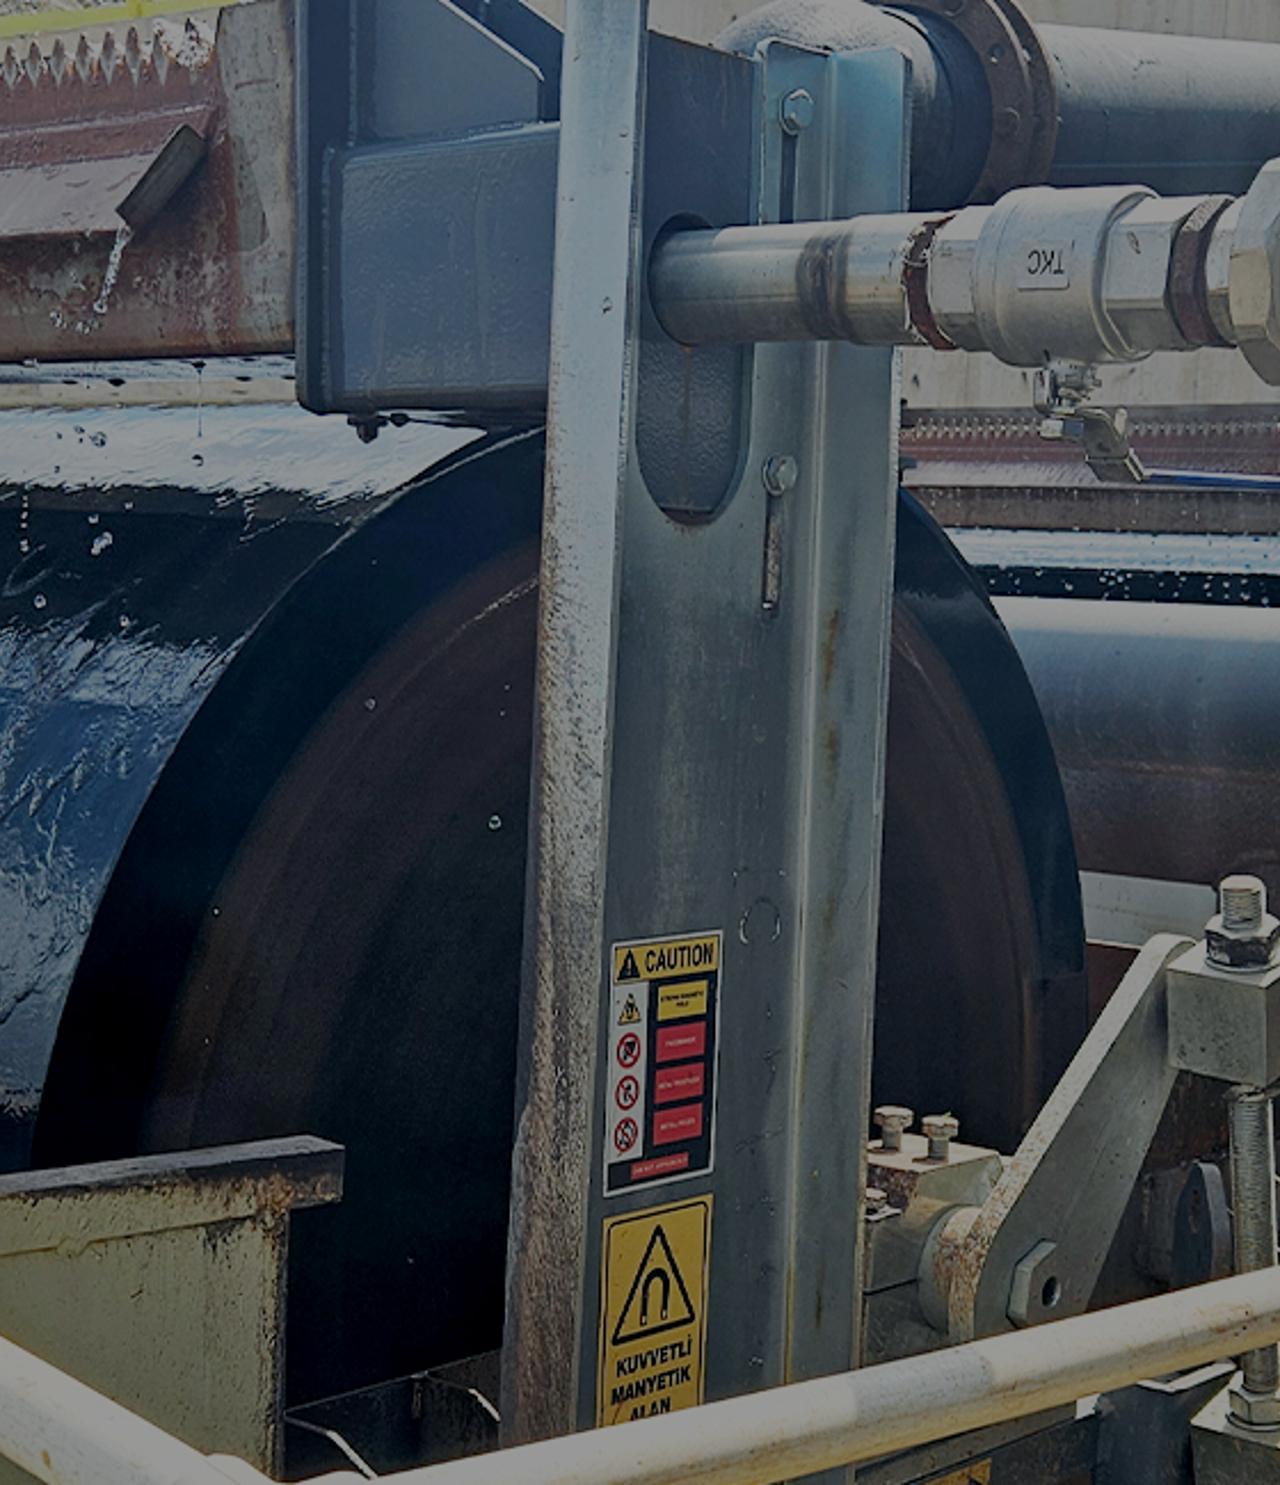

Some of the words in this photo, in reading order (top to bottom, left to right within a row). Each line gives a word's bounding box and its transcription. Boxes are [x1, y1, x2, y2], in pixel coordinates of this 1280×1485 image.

[1027, 249, 1064, 275] TKC
[645, 942, 714, 973] CAUTION
[616, 1333, 692, 1378] KUVVETLİ
[630, 1396, 671, 1421] ALAN
